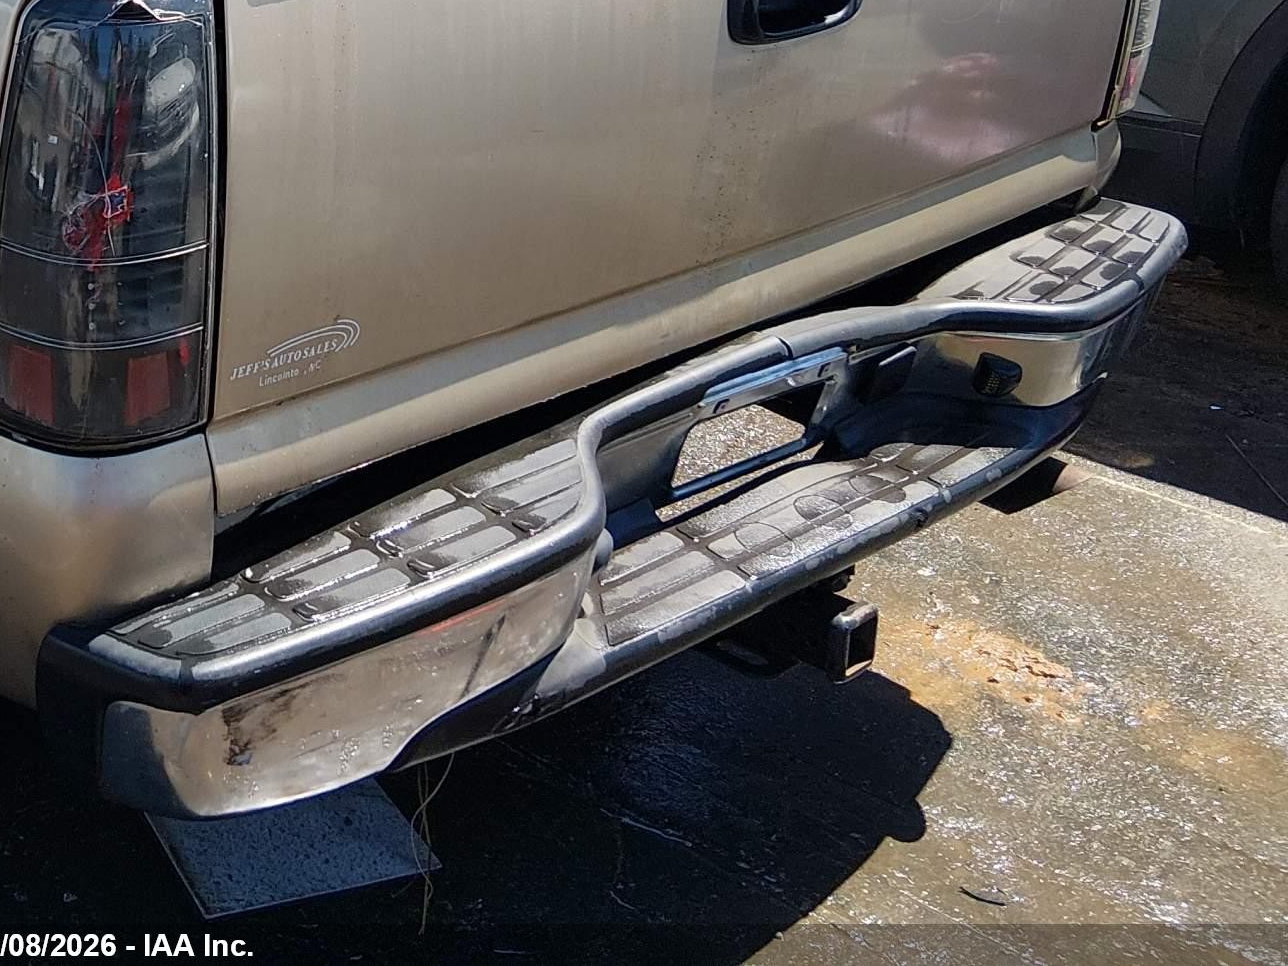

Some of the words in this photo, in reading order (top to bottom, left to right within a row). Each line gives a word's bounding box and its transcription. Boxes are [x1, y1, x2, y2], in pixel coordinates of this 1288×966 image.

[230, 358, 271, 381] JEFF'S
[271, 351, 302, 369] AUTO
[302, 339, 338, 359] SALES
